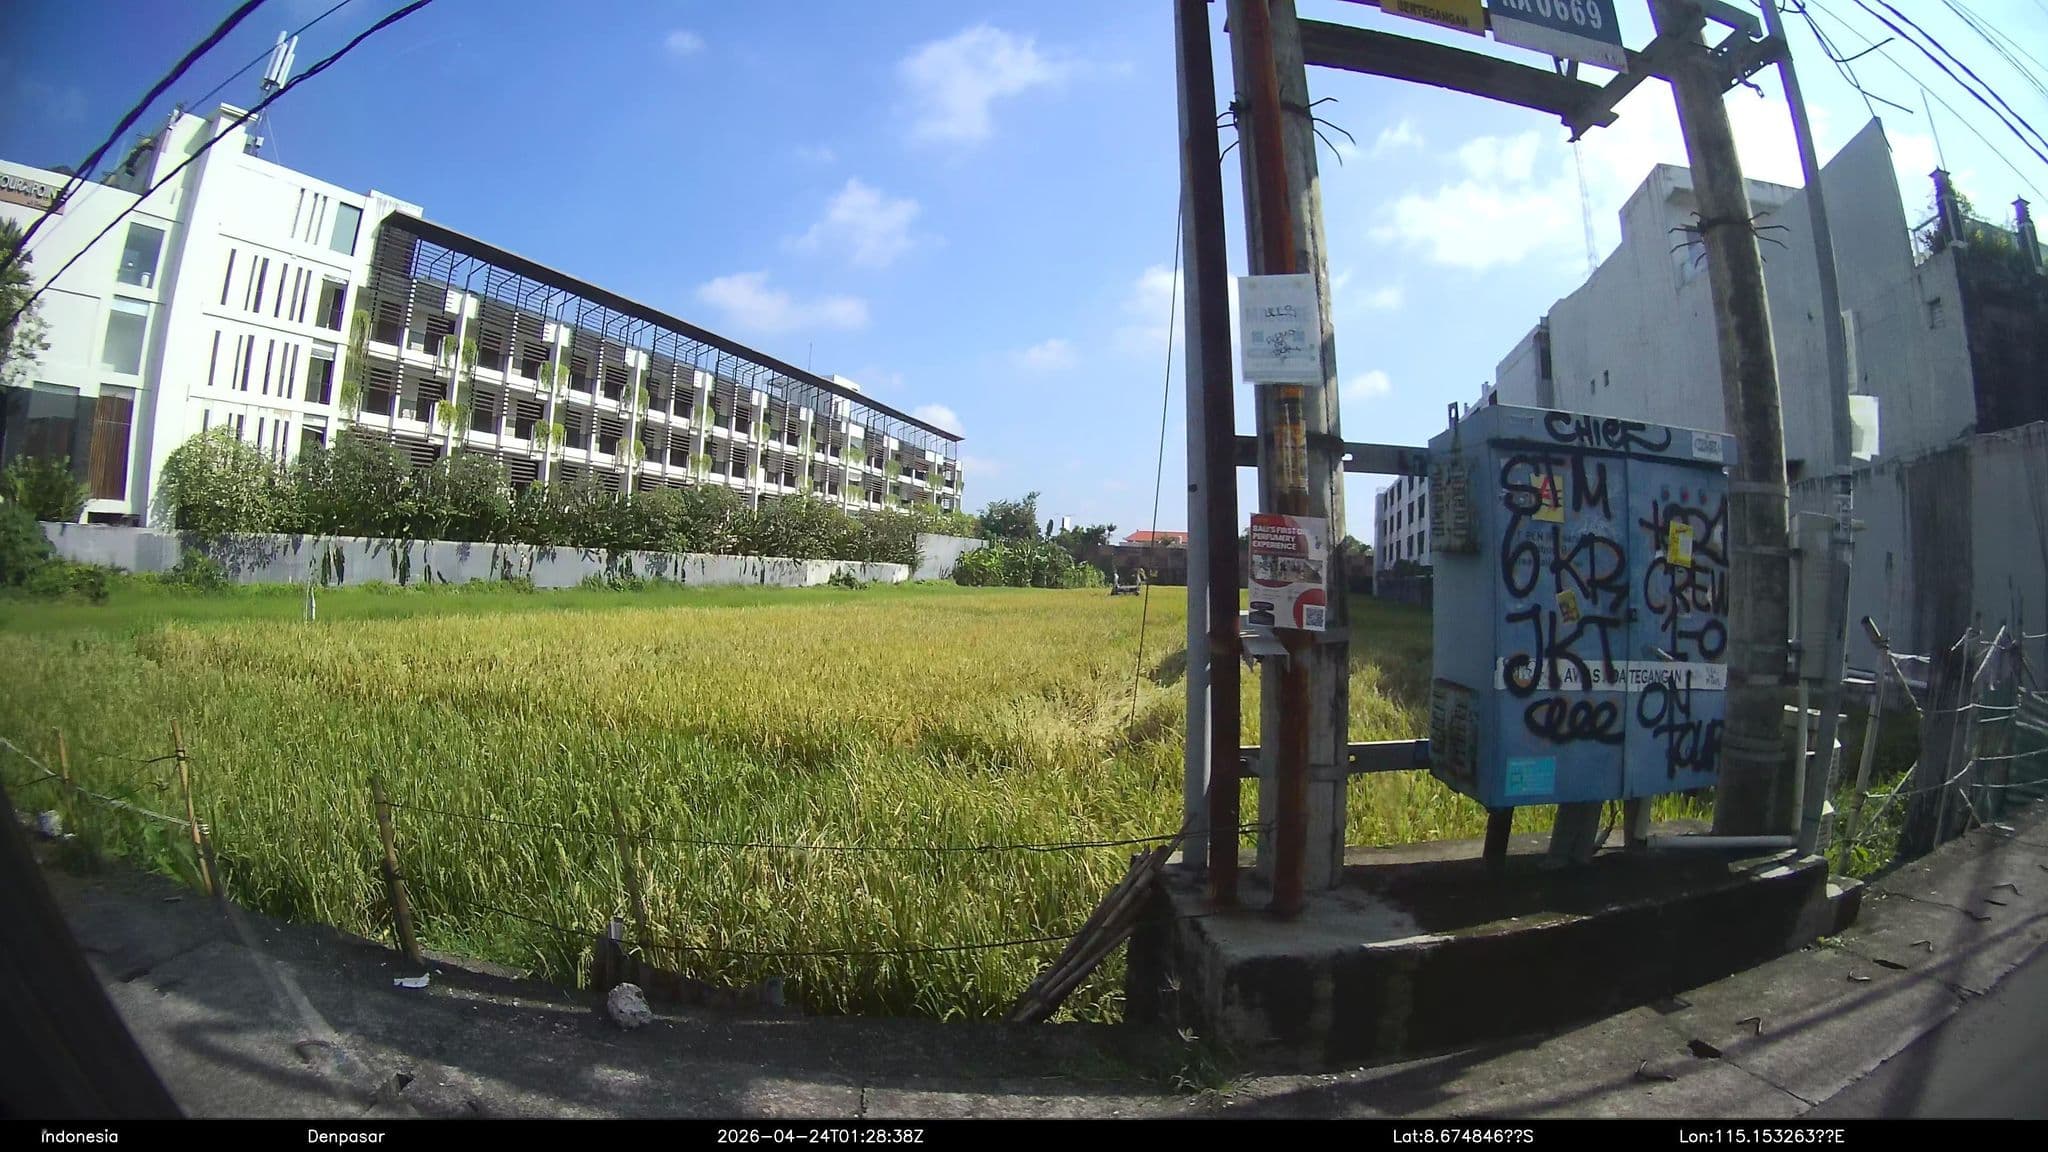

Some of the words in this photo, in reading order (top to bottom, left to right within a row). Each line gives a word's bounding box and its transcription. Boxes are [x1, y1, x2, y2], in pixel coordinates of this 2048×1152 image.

[1252, 533, 1296, 542] PERFUMERY
[1252, 540, 1297, 550] EXPERIENCE
[1503, 605, 1623, 697] JKT
[1629, 669, 1683, 685] TEGANGAN
[1637, 670, 1692, 728] ON
